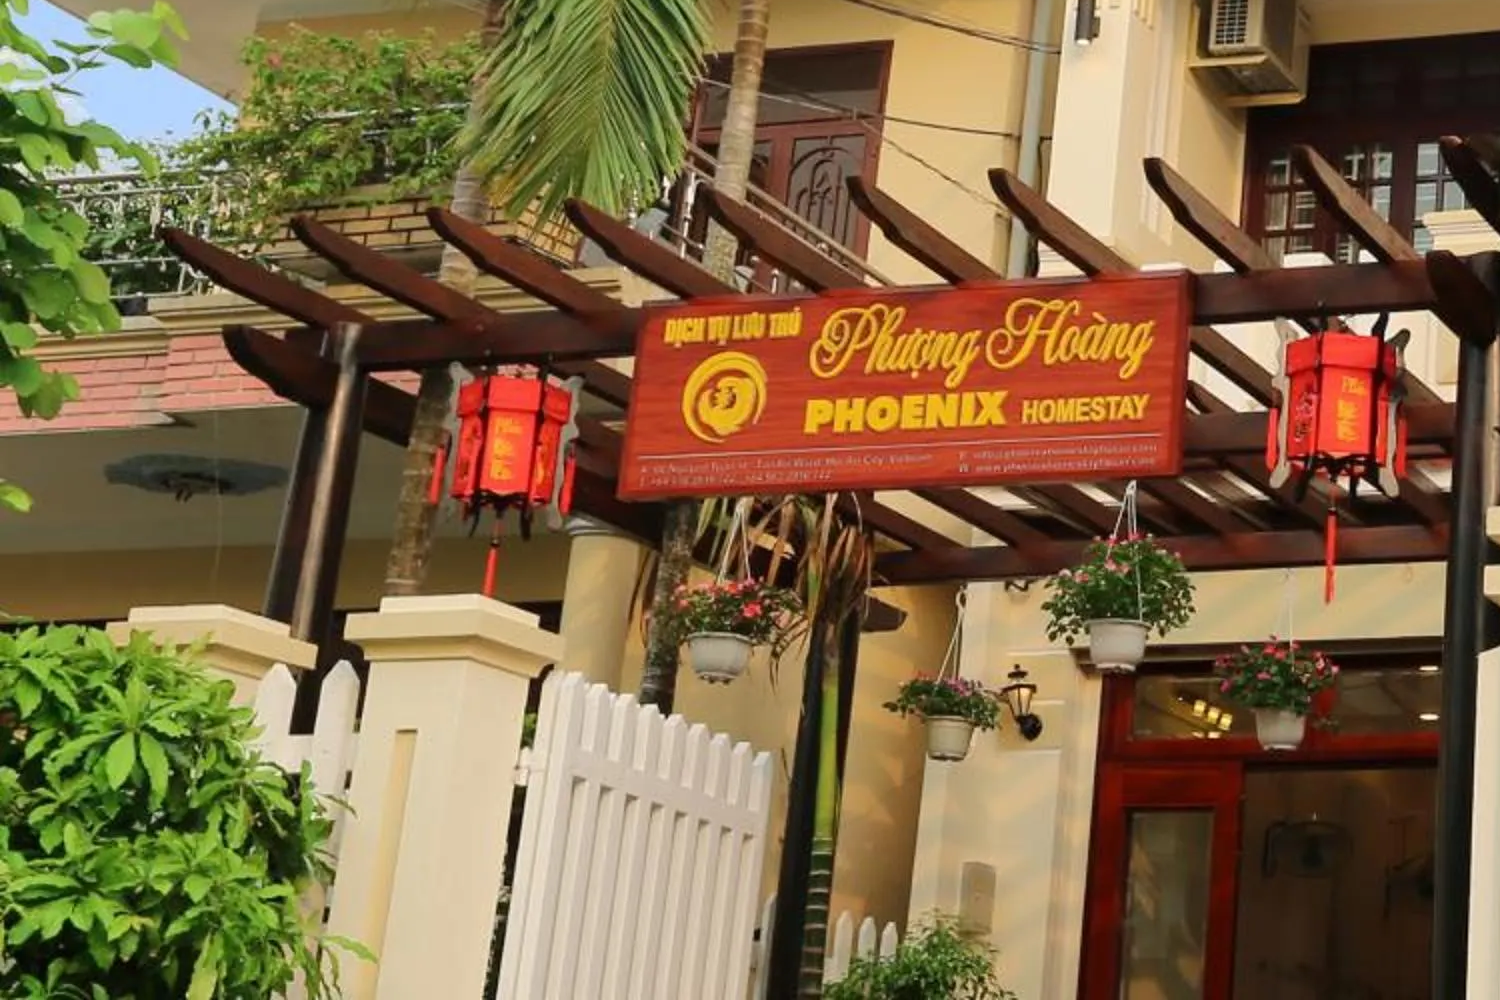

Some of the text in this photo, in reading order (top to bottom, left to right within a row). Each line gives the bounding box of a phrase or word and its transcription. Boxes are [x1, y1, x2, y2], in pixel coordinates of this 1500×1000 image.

[809, 298, 1155, 388] Phượng Hoàng
[804, 391, 1150, 434] PHOENIX HOMESTAY
